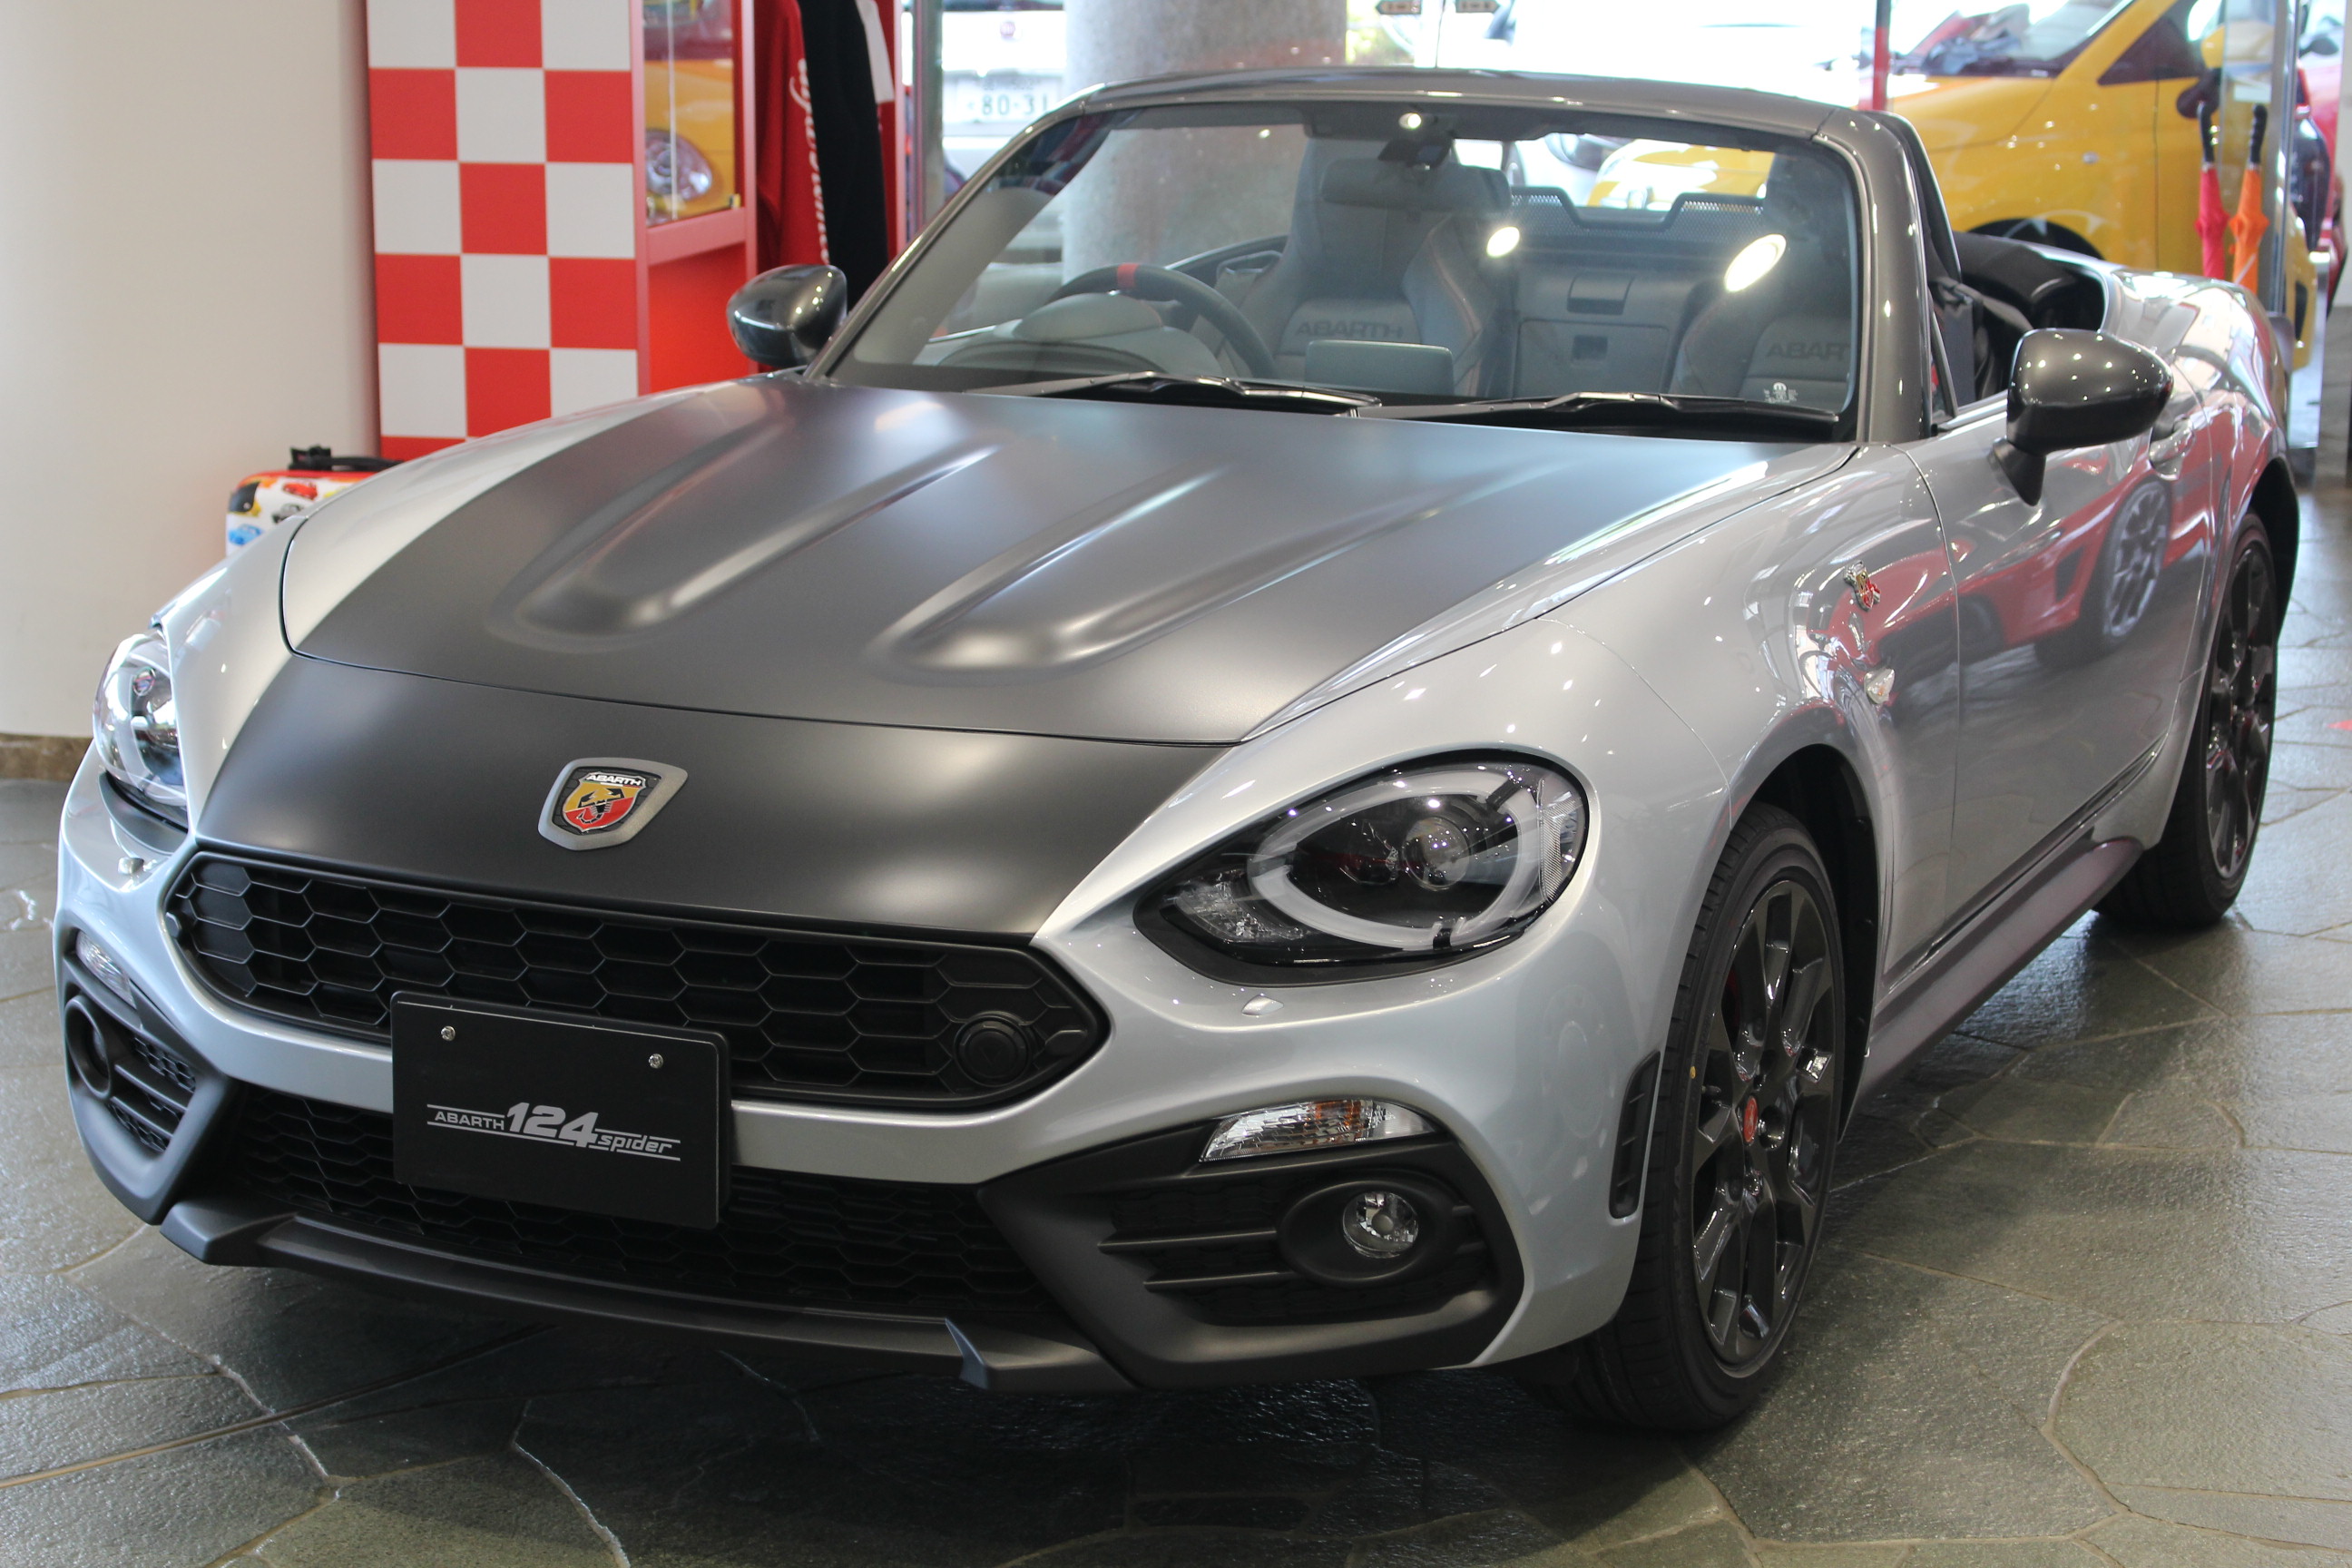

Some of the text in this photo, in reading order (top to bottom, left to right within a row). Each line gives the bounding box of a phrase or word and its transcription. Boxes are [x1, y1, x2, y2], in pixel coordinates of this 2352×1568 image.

[1295, 321, 1405, 338] ABARTH
[586, 774, 642, 786] ABARTH
[434, 1102, 672, 1154] ABARTH 124 spider
